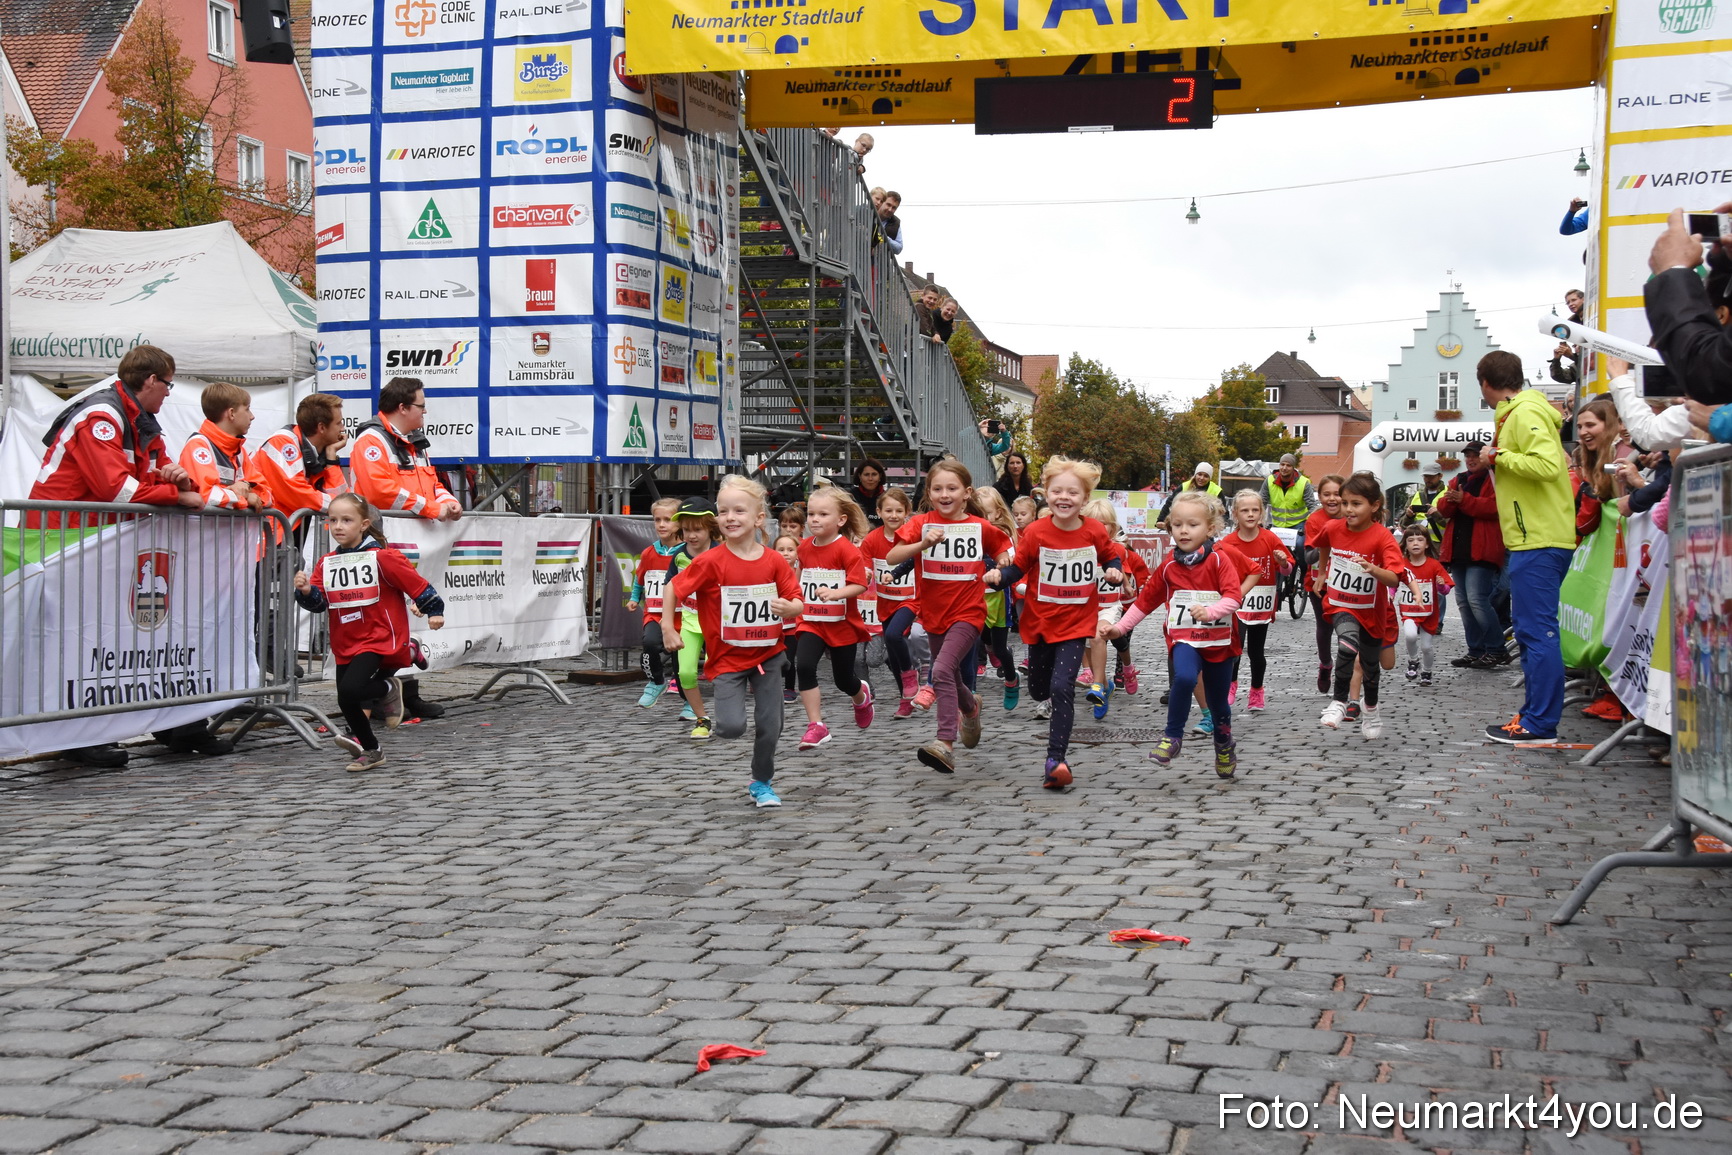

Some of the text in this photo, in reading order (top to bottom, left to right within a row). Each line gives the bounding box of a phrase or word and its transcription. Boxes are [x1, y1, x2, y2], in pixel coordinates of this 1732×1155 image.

[441, 1, 470, 12] CODE
[500, 4, 562, 19] RAIL.ONE
[441, 11, 475, 24] CLINIC
[672, 7, 864, 29] Neumarkter Stadtlauf
[1659, 6, 1717, 33] SCHAU
[1350, 36, 1550, 69] Neumarkter Stadtlauf
[395, 72, 470, 86] Neumarkter Tagblatt
[519, 61, 569, 83] Burgis
[785, 77, 953, 95] Neumarkter Stadtlauf
[1168, 78, 1195, 123] 2
[1618, 92, 1711, 108] RAIL.ONE
[411, 145, 475, 160] VARIOTEC
[545, 152, 588, 165] energie
[326, 162, 366, 175] energie
[497, 205, 563, 222] charivari
[385, 290, 448, 300] RAIL.ONE
[526, 288, 553, 301] Braun
[386, 349, 443, 367] swn
[518, 360, 566, 369] Neumarkter
[331, 369, 367, 381] energie
[509, 369, 574, 381] Lammsbräu
[495, 427, 561, 436] RAIL.ONE
[1392, 428, 1440, 442] BMW
[941, 563, 965, 573] Helga
[1045, 561, 1094, 584] 7109
[330, 564, 373, 588] 7013
[445, 570, 505, 588] NeuerMarkt
[1333, 568, 1374, 593] 7040
[339, 591, 364, 601] Sophia
[1058, 588, 1081, 597] Laura
[1402, 590, 1430, 603] 703
[809, 606, 828, 614] Paula
[745, 629, 768, 639] Frida
